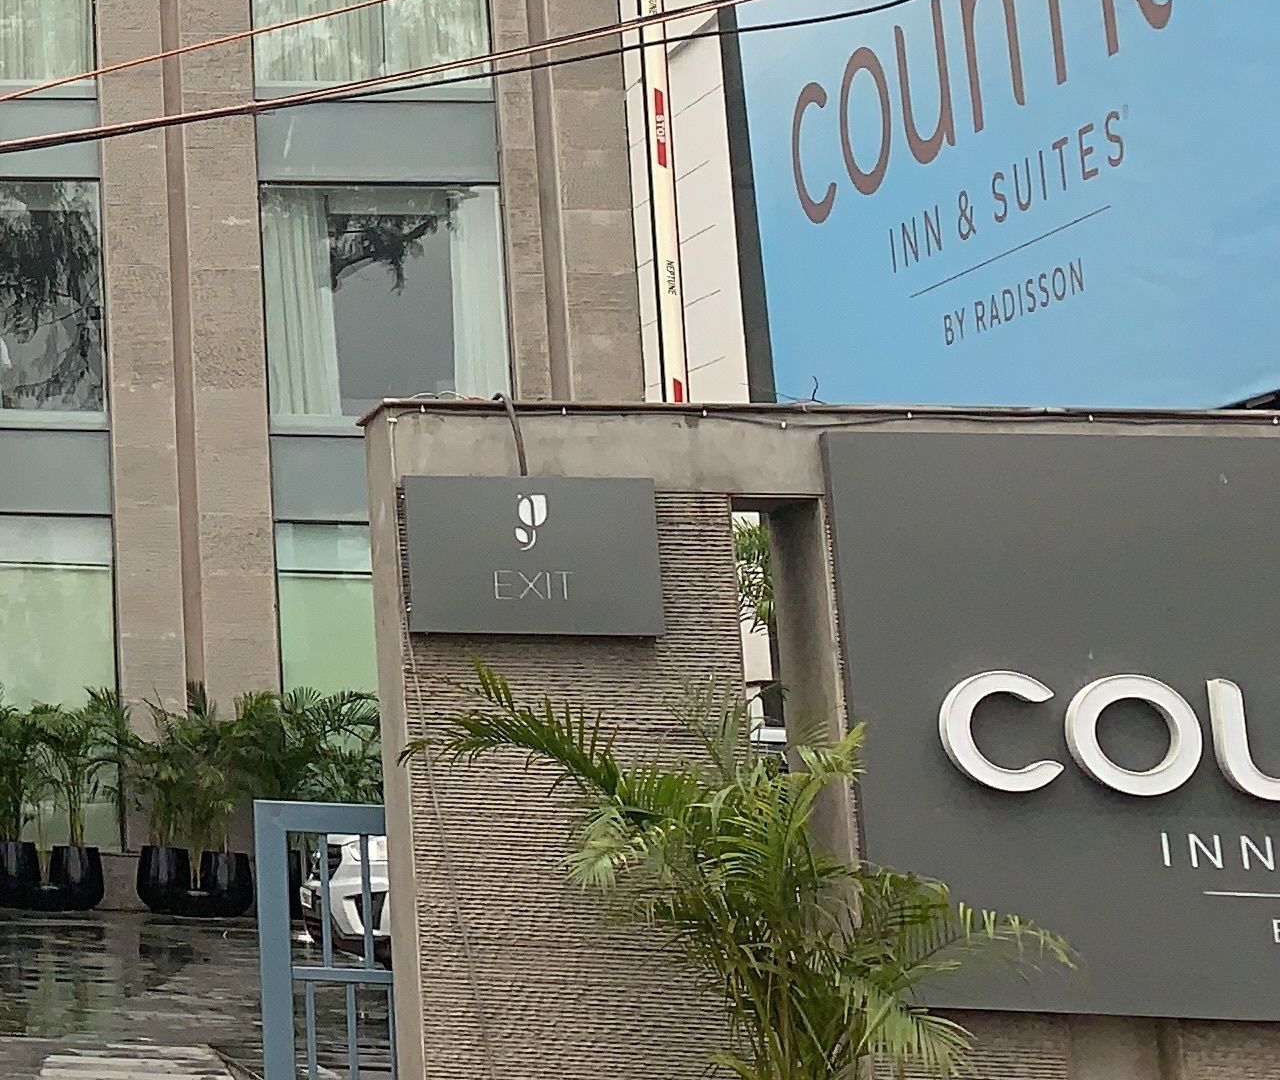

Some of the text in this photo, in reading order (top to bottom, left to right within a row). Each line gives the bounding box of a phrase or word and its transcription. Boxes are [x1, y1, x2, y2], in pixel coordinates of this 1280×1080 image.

[656, 114, 666, 144] STOP
[889, 205, 943, 274] INN
[957, 190, 977, 241] &
[944, 257, 1085, 346] BY RADISSON
[494, 571, 573, 600] EXIT
[1160, 831, 1277, 871] INN
